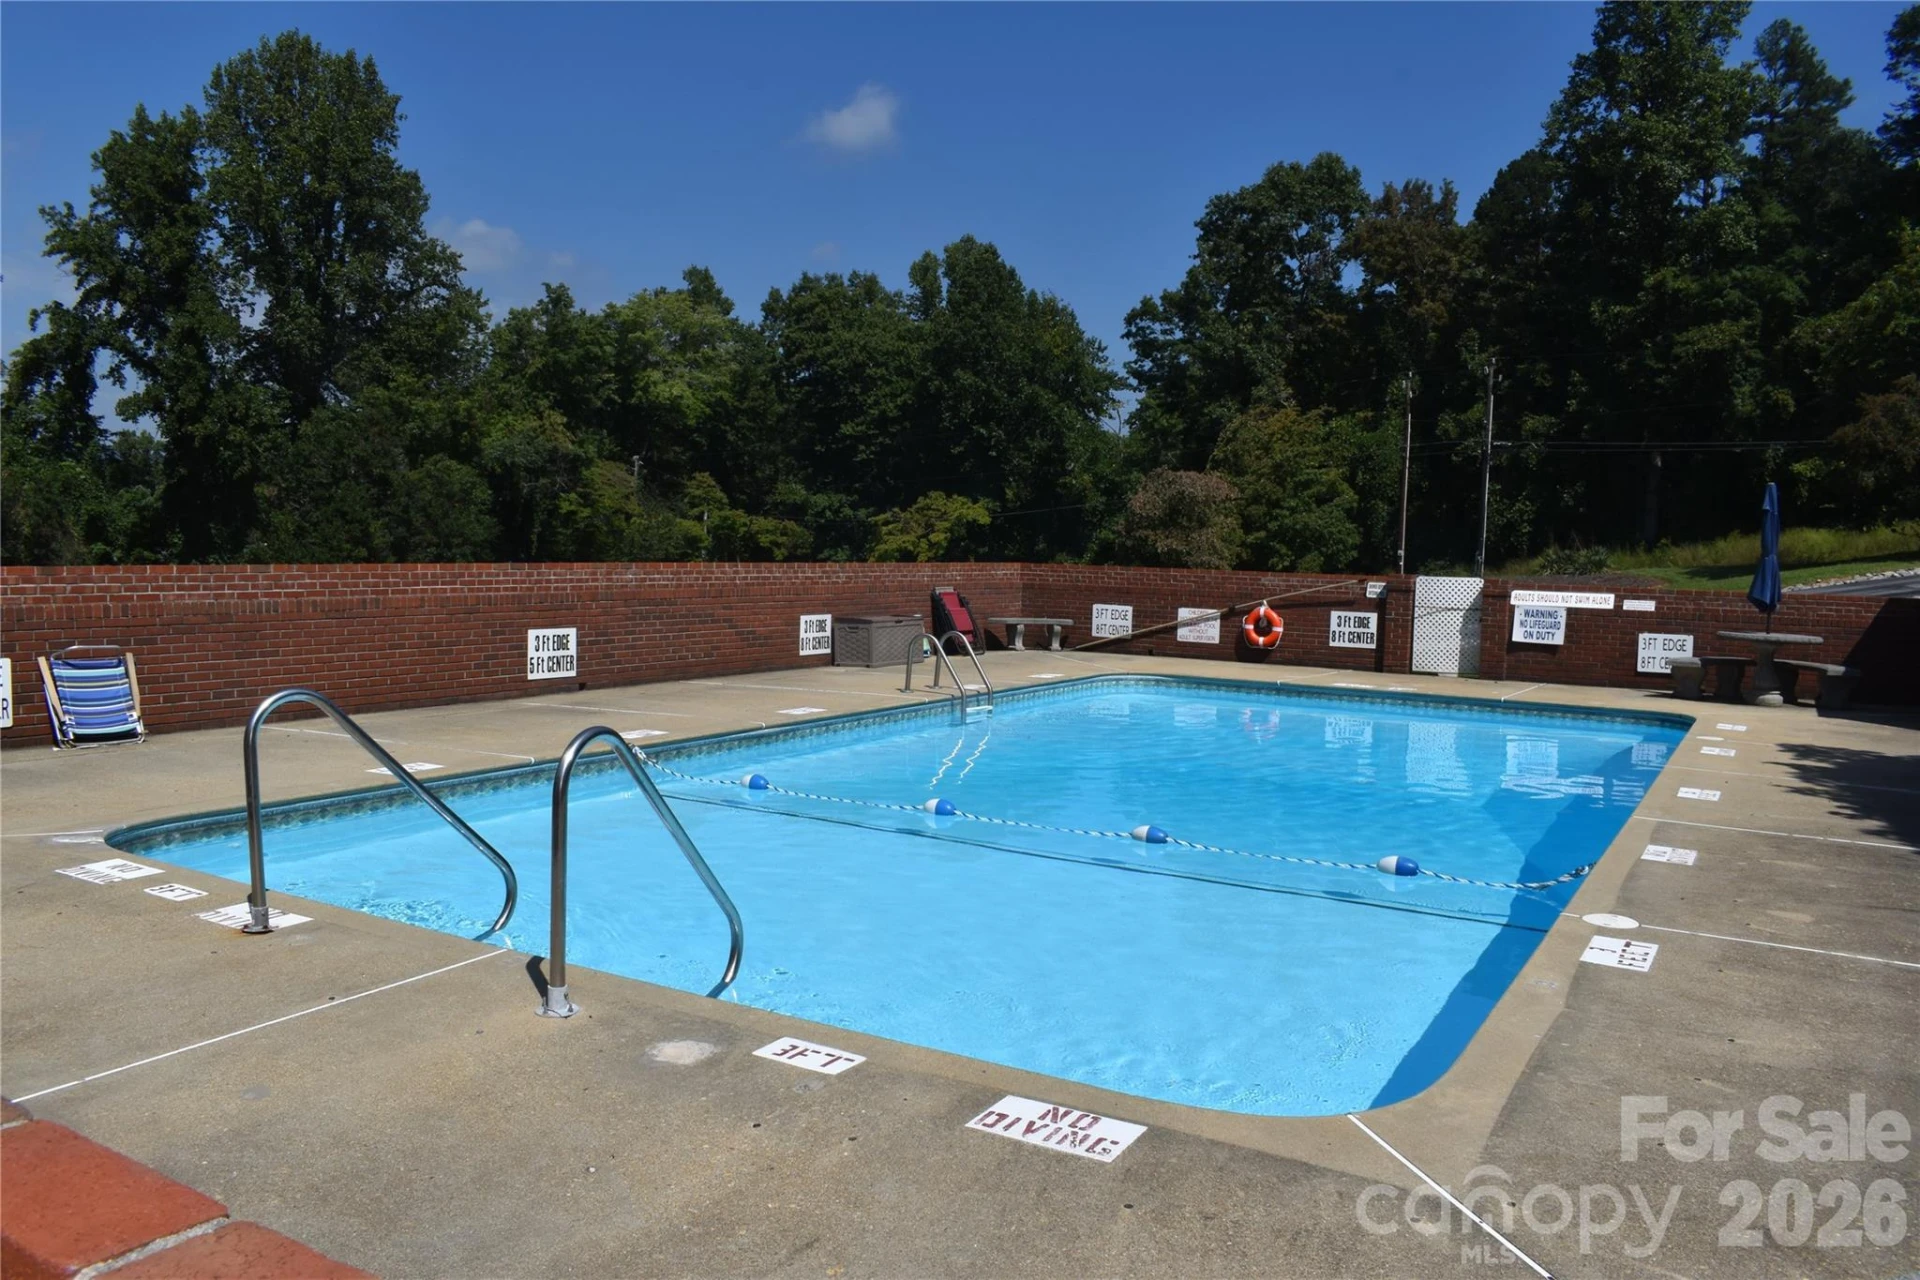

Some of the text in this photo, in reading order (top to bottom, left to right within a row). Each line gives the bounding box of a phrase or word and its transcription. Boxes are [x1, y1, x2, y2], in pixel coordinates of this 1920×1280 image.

[1514, 593, 1611, 605] ADULTS SHOULD NOT SWIM ALONE
[1110, 609, 1129, 621] EDGE
[1524, 608, 1558, 620] WARNING
[815, 618, 827, 633] EDGE
[1336, 615, 1342, 628] 3
[1353, 616, 1371, 629] EDGE
[1519, 619, 1561, 630] NO LIFEGUARD
[1331, 630, 1337, 643] 8
[1347, 631, 1375, 645] CENTER
[1523, 630, 1556, 641] ON DUTY
[534, 635, 540, 653] 3
[552, 633, 570, 651] EDGE
[812, 636, 830, 650] CENTER
[1662, 638, 1688, 652] EDGE
[529, 656, 535, 674] 5
[547, 654, 575, 673] CENTER
[1038, 1106, 1102, 1132] NO
[974, 1110, 1120, 1156] DIVING
